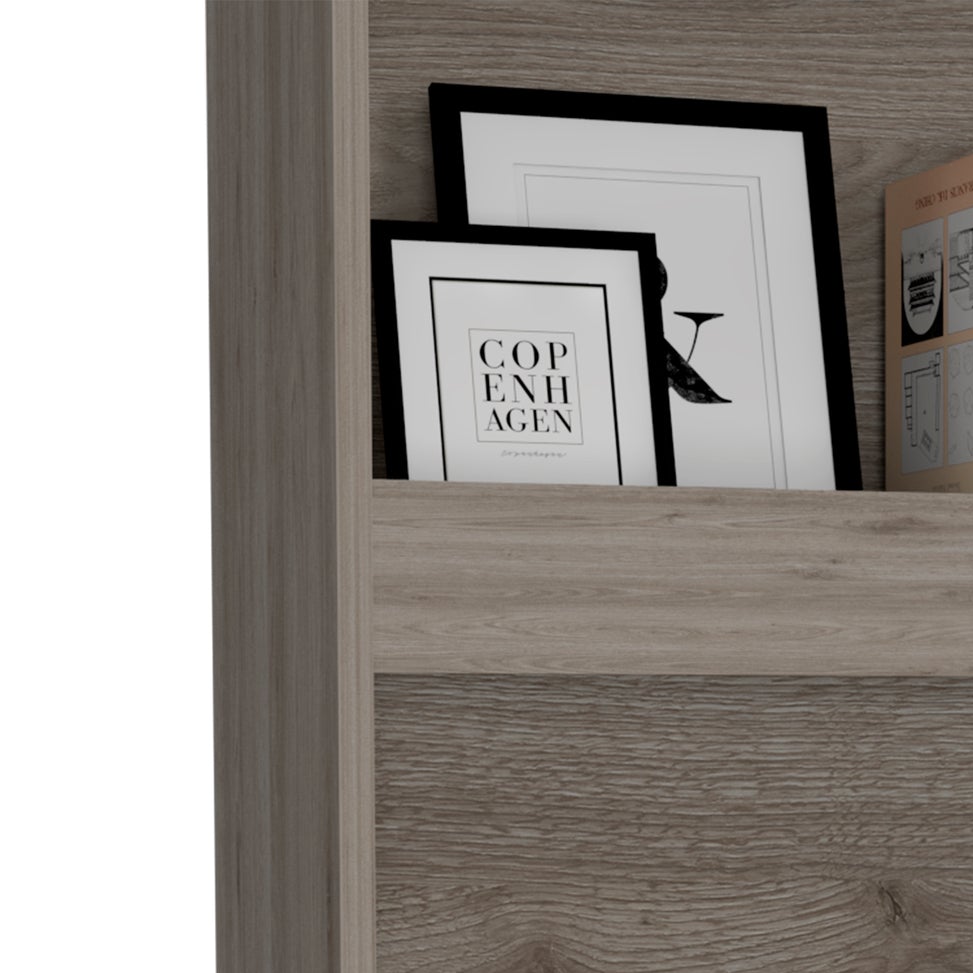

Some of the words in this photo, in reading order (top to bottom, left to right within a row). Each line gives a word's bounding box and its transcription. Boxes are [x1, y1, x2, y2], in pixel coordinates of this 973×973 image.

[479, 338, 568, 371] COP
[481, 373, 572, 405] ENH
[484, 407, 574, 434] AGEN
